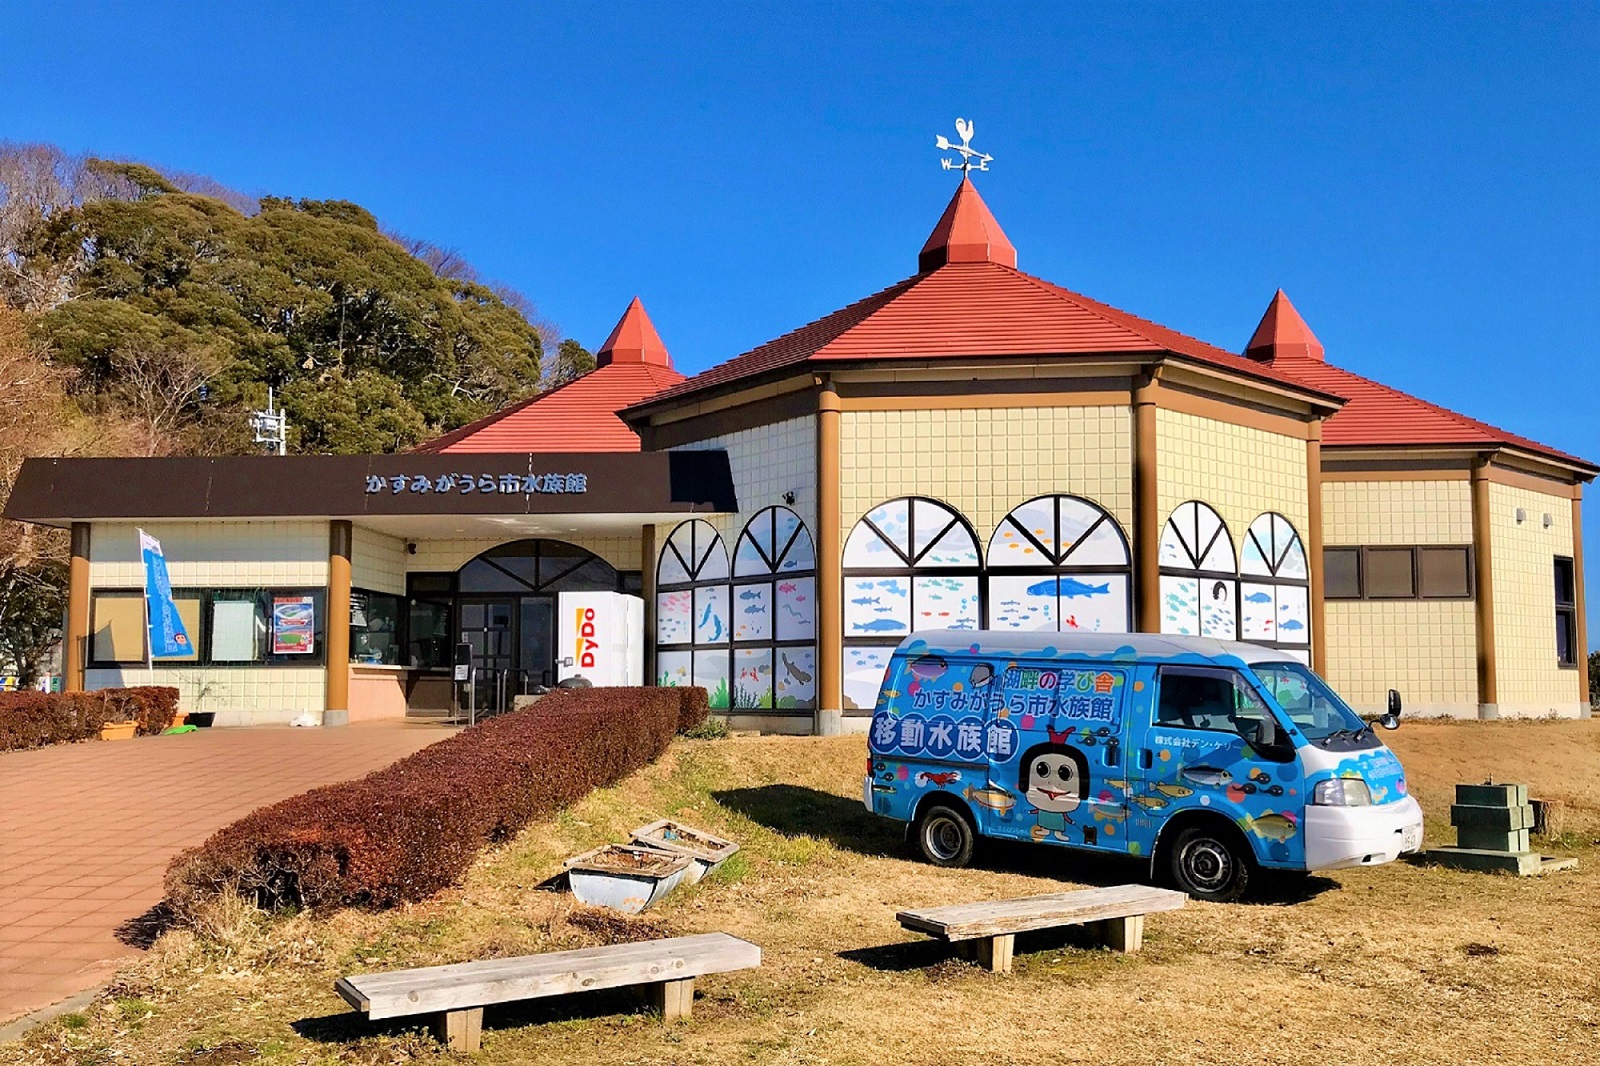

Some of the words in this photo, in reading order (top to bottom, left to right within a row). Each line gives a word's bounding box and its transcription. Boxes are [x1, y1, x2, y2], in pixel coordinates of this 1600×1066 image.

[941, 158, 952, 170] W
[980, 159, 989, 171] E
[365, 472, 588, 494] かすみがうら市水族館
[581, 607, 599, 668] DyDo
[1004, 668, 1115, 694] 湖畔の学び舎
[913, 688, 1114, 721] かすみがうら市水族館
[875, 717, 1013, 757] 移動水族館
[1154, 734, 1242, 752] 株式会社デン・ケリー
